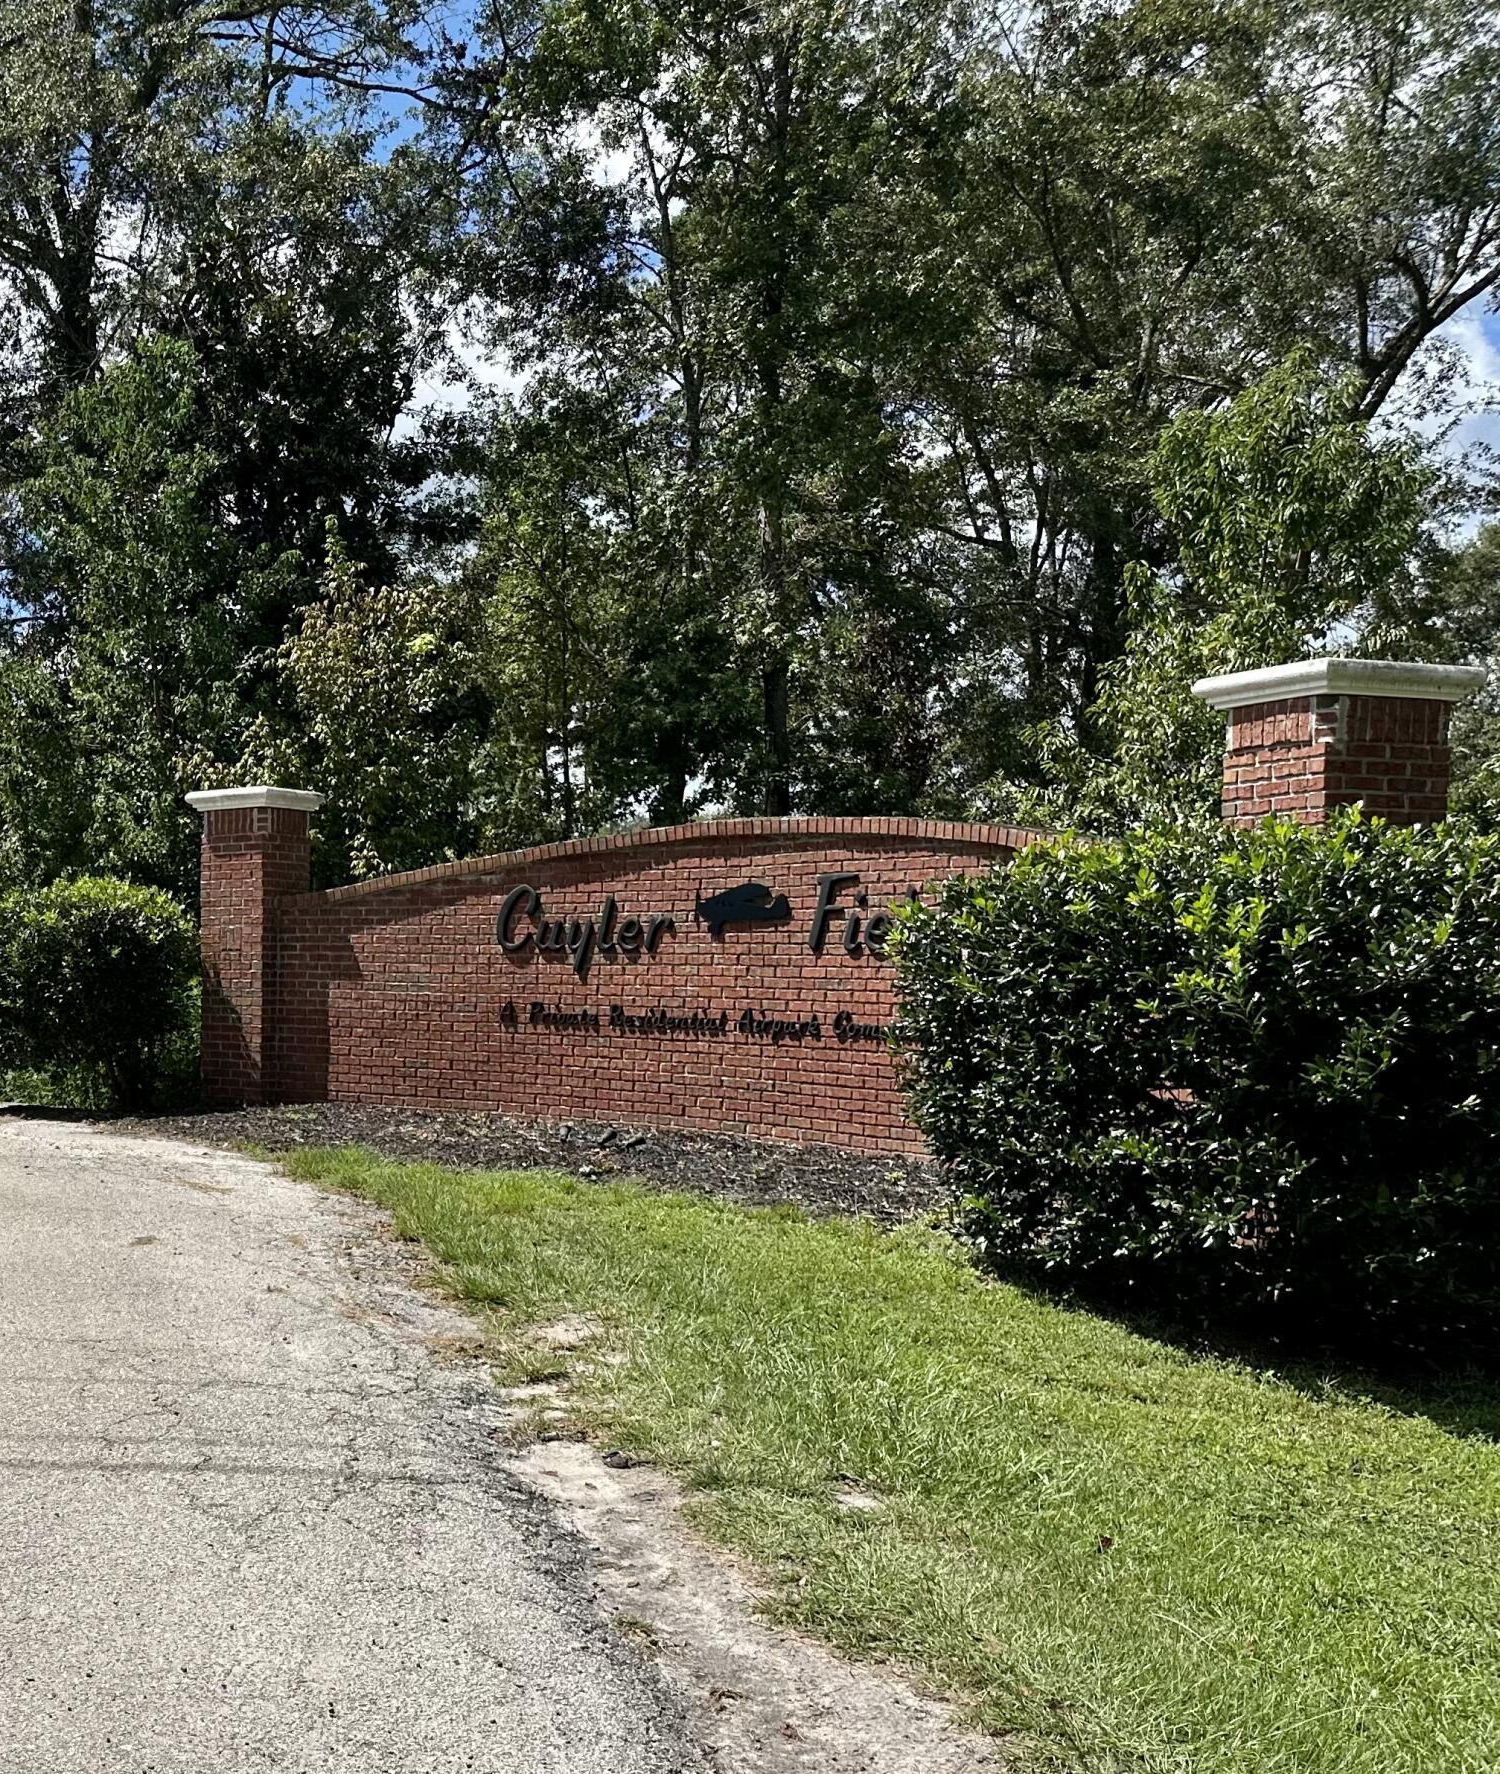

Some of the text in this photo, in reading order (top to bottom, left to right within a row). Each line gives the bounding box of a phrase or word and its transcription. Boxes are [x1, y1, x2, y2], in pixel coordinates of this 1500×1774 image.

[497, 872, 919, 974] Cuyler Fie
[500, 1001, 517, 1027] A
[530, 1002, 598, 1028] Private
[610, 1004, 728, 1032] Residential
[737, 1008, 821, 1040] Airpark
